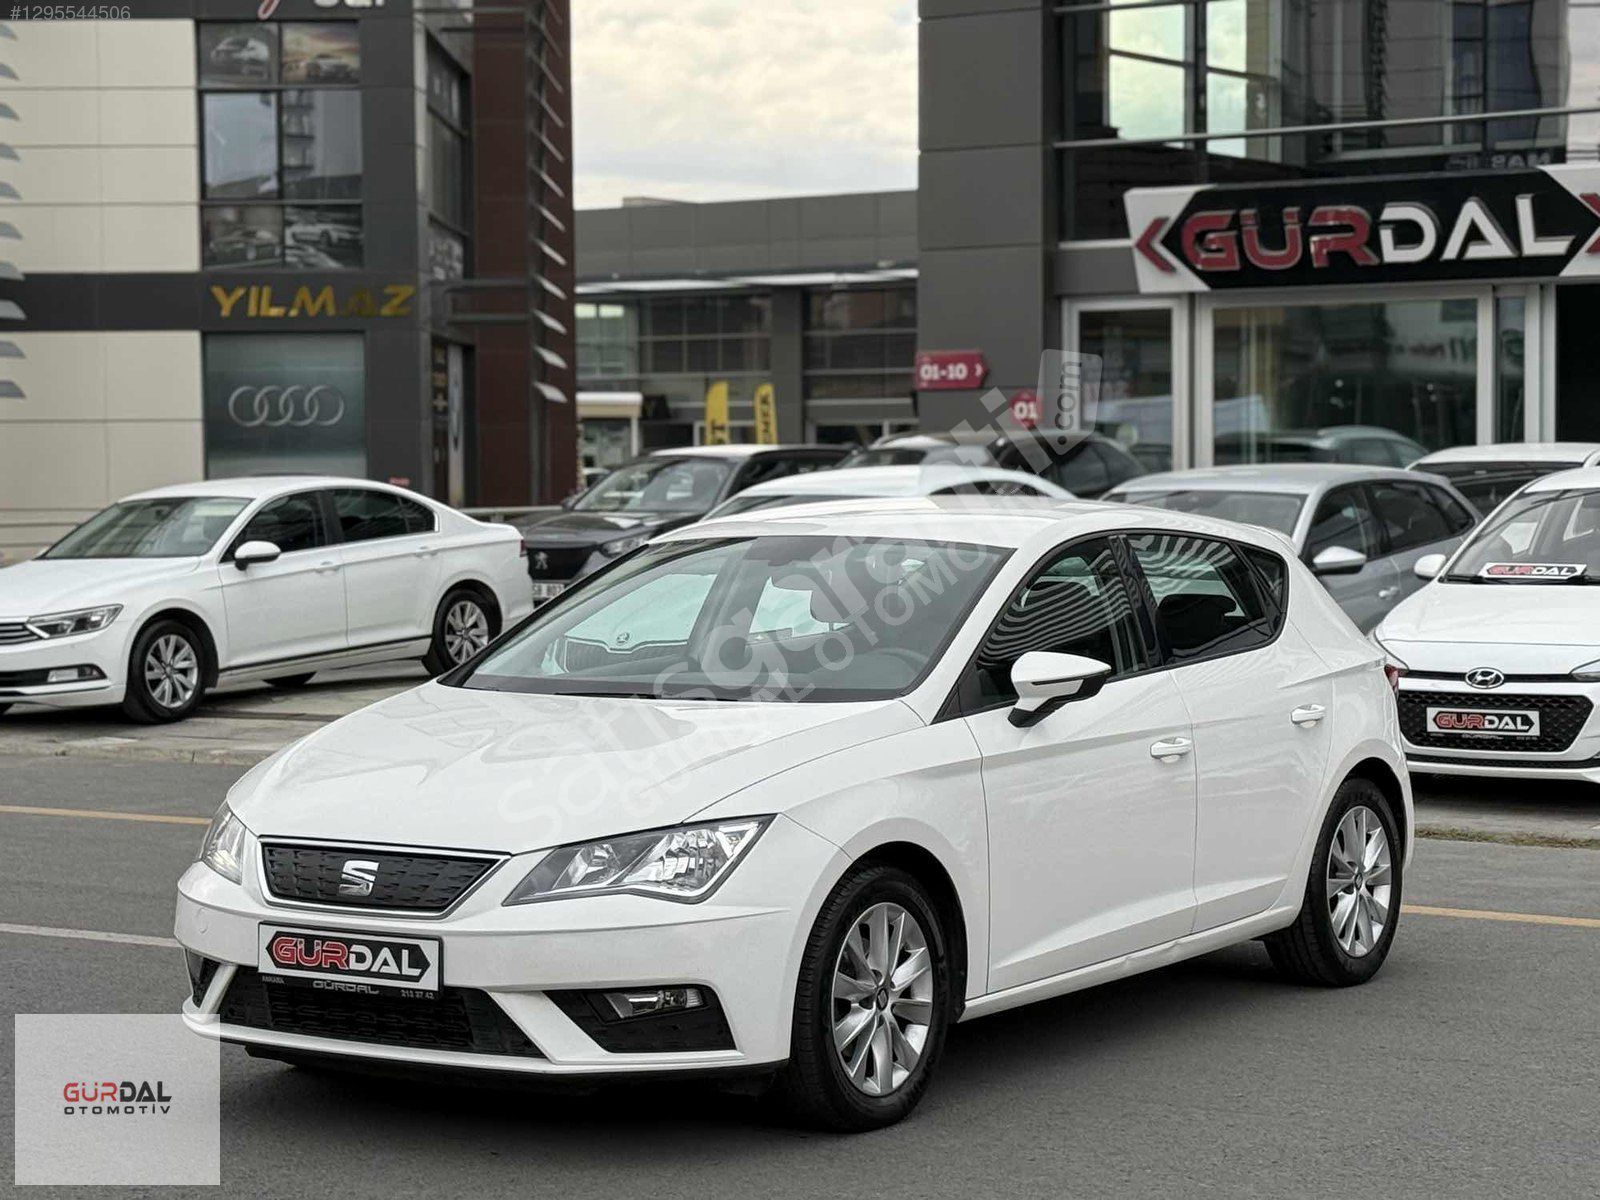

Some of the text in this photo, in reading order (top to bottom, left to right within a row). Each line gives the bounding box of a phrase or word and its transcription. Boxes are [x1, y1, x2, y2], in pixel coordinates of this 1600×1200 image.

[210, 285, 416, 317] YILMAZ
[920, 363, 968, 380] 01-10
[1014, 402, 1038, 420] 01
